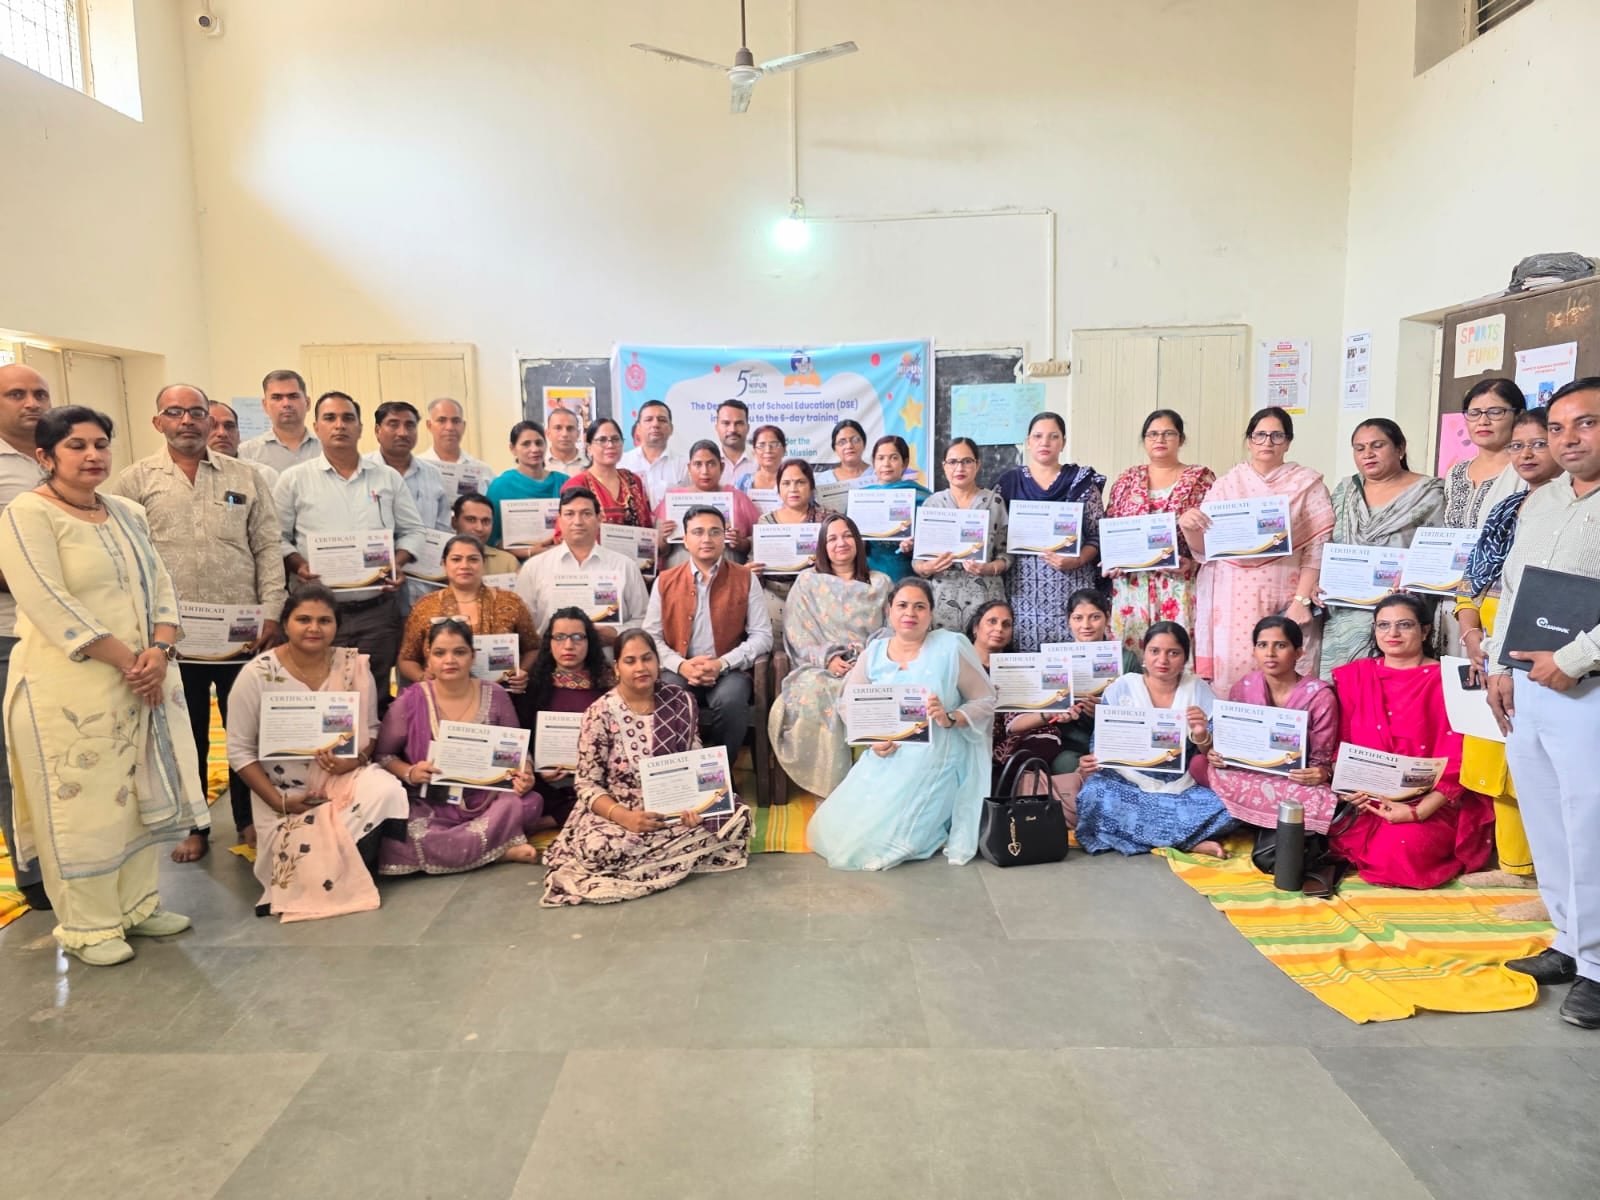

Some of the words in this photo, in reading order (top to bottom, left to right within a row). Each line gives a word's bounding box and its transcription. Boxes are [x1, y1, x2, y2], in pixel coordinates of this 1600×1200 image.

[1461, 324, 1501, 344] SPORTS
[1467, 347, 1499, 367] FUND
[736, 369, 752, 397] 5
[691, 402, 705, 410] The
[757, 402, 765, 410] of
[767, 401, 793, 410] School
[795, 400, 835, 410] Education
[836, 399, 859, 411] (DSE)
[780, 414, 806, 424] 6-day
[806, 413, 839, 424] training
[790, 448, 817, 456] Mission
[1209, 502, 1249, 511] CERTIFICATE
[314, 535, 356, 543] CERTIFICATE
[1420, 531, 1456, 539] CERTIFICATE
[1330, 547, 1370, 556] CERTIFICATE
[1103, 709, 1146, 717] CERTIFICATE
[1220, 705, 1264, 715] CERTIFICATE
[447, 725, 491, 735] CERTIFICATE
[1348, 747, 1399, 763] CERTIFICATE
[647, 756, 689, 768] CERTIFICATE
